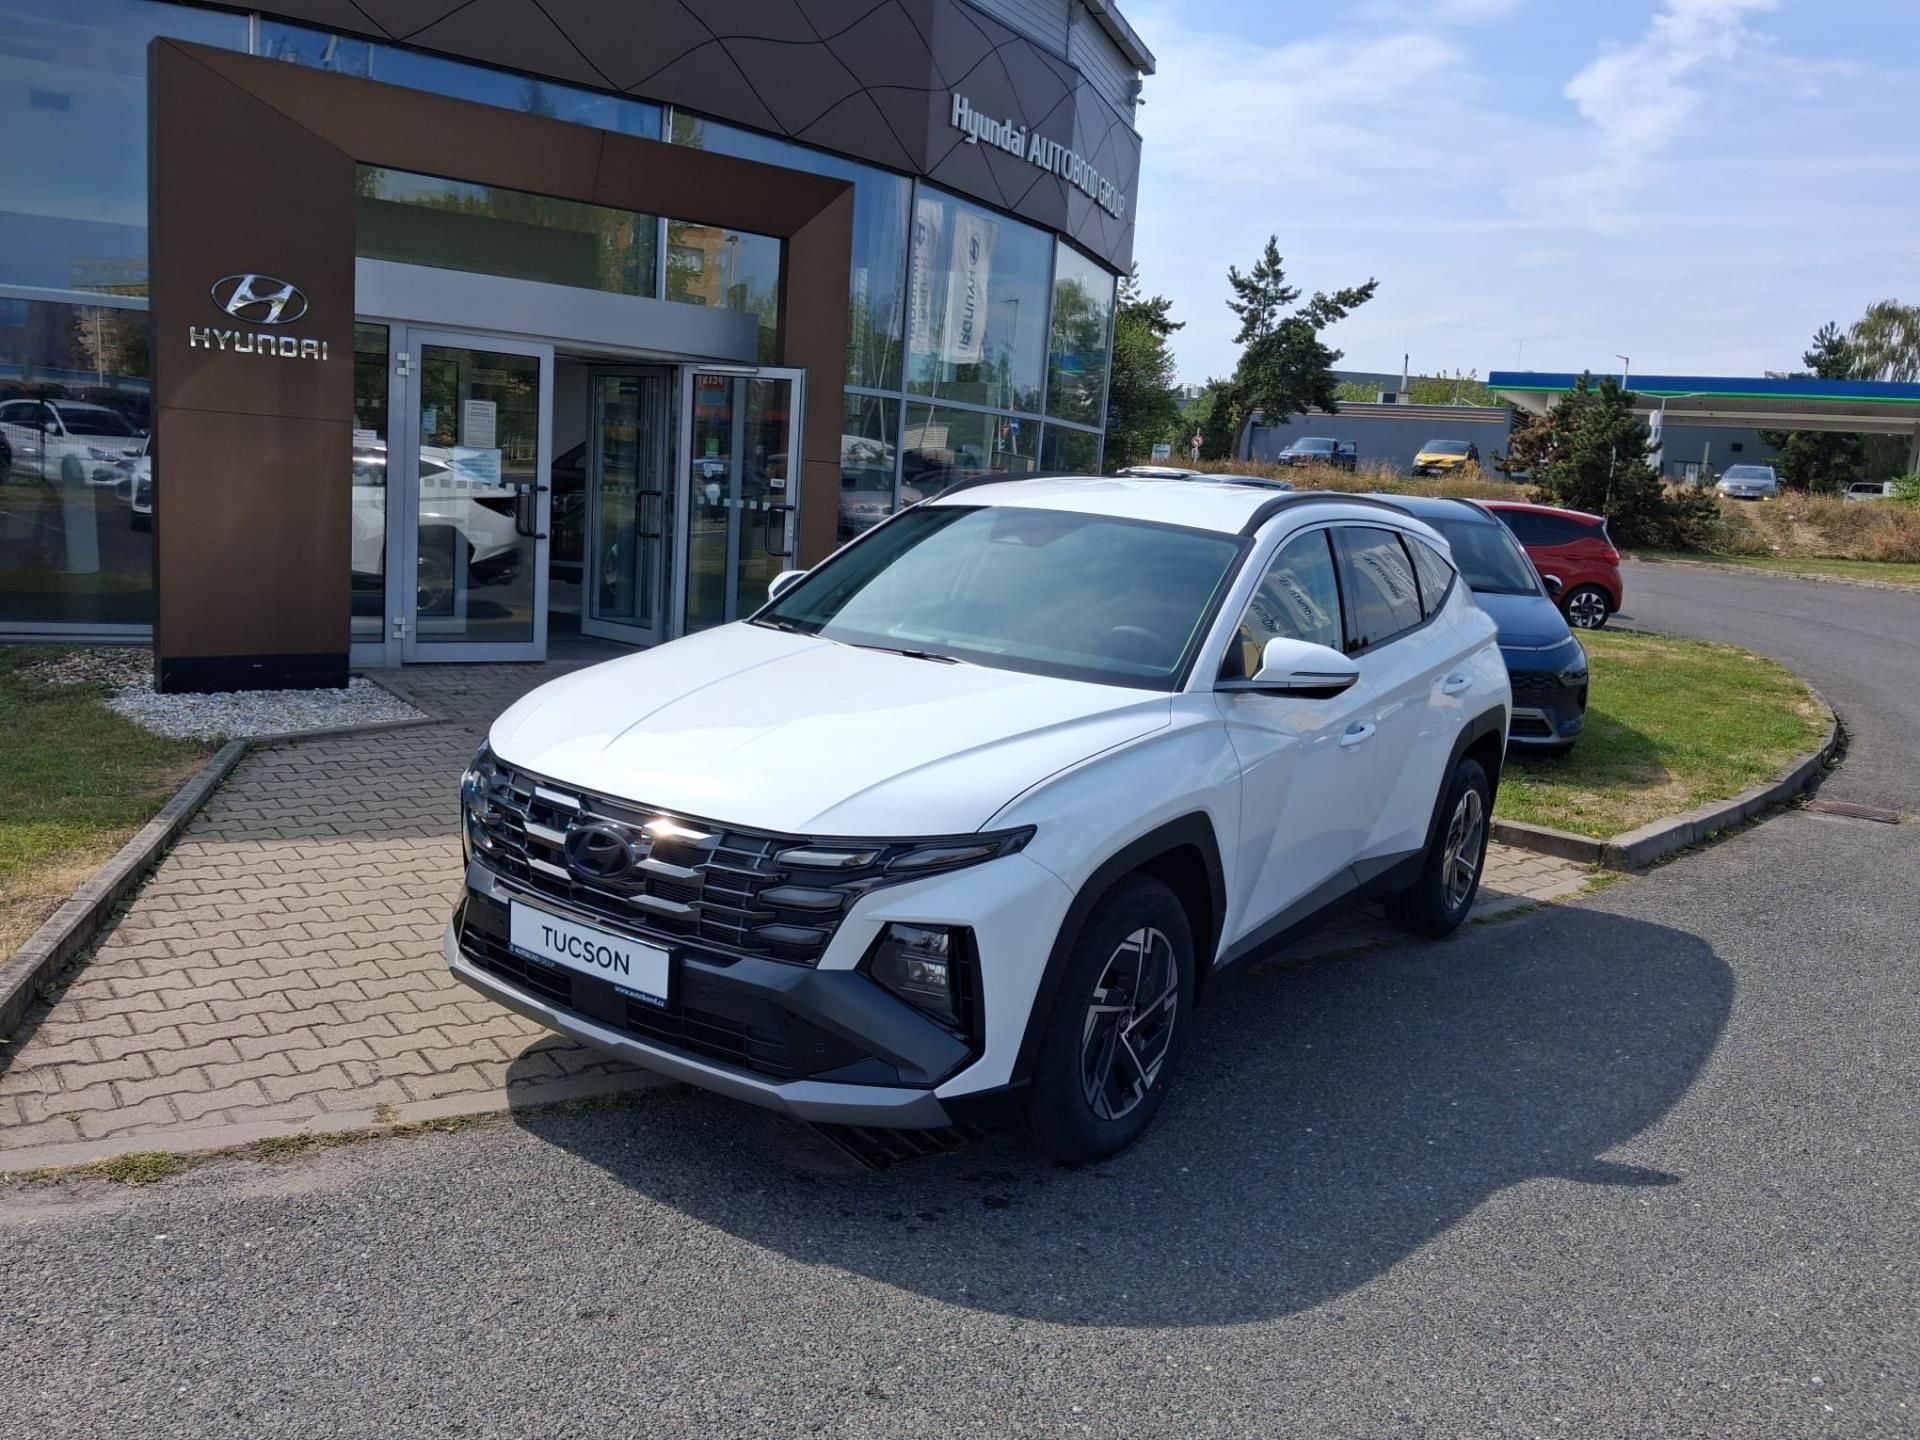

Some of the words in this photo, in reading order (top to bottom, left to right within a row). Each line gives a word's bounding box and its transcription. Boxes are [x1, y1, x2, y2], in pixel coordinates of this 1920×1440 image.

[951, 93, 1026, 158] Hyundai
[1027, 132, 1098, 200] AUTOBOND
[1099, 177, 1126, 220] GROUP
[189, 325, 328, 361] HYUNDAI
[958, 270, 977, 351] HYUNDAI
[542, 926, 629, 975] TUCSON
